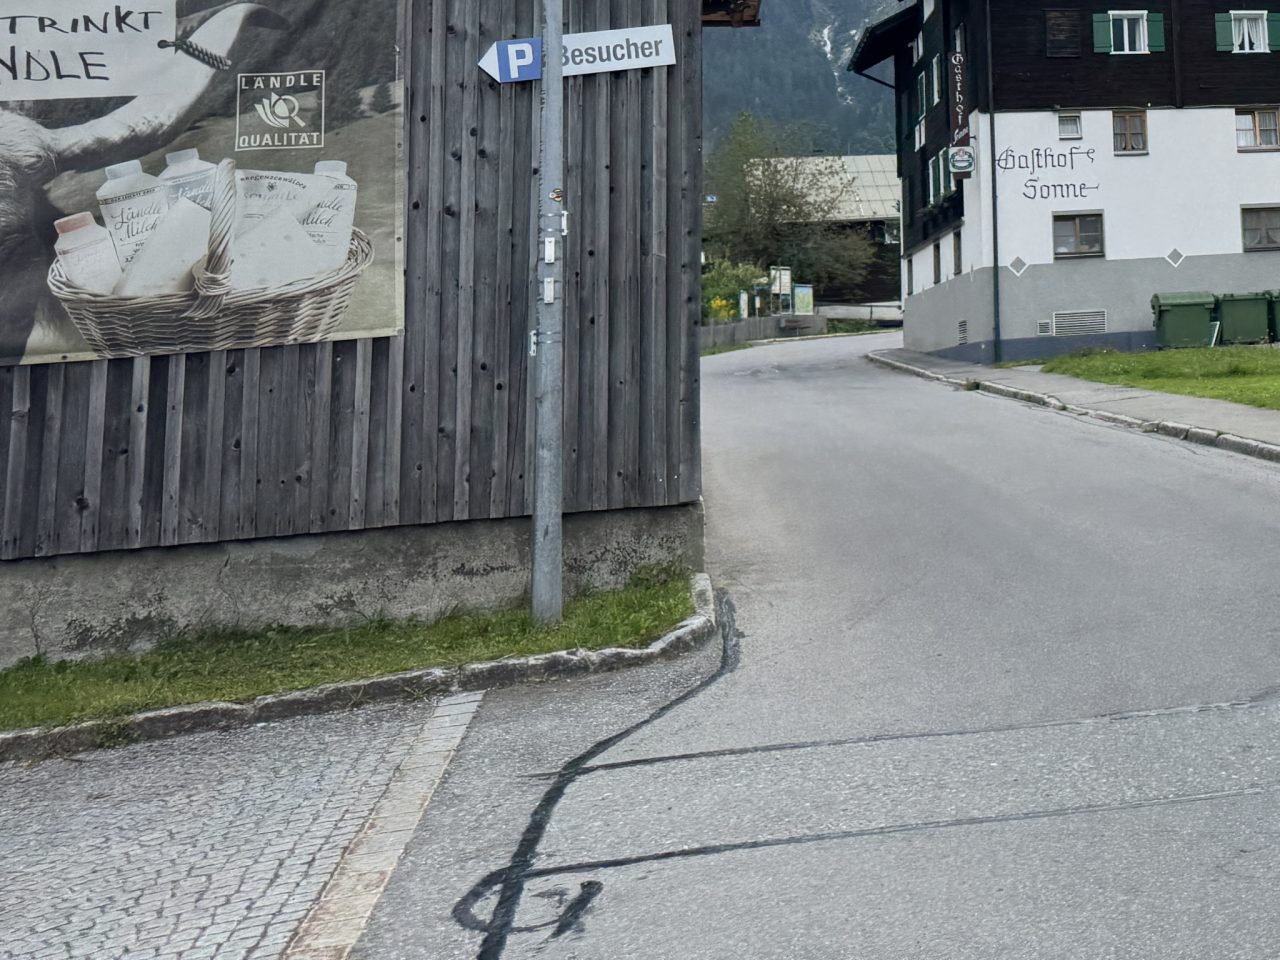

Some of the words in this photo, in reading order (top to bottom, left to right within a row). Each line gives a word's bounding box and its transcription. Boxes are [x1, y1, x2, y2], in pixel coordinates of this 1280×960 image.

[0, 5, 163, 35] TRINKT
[507, 43, 533, 79] P
[241, 73, 321, 90] LÄNDLE
[951, 53, 964, 125] Gasthof
[239, 132, 320, 147] QUALITÄT
[1022, 177, 1099, 200] Sonne
